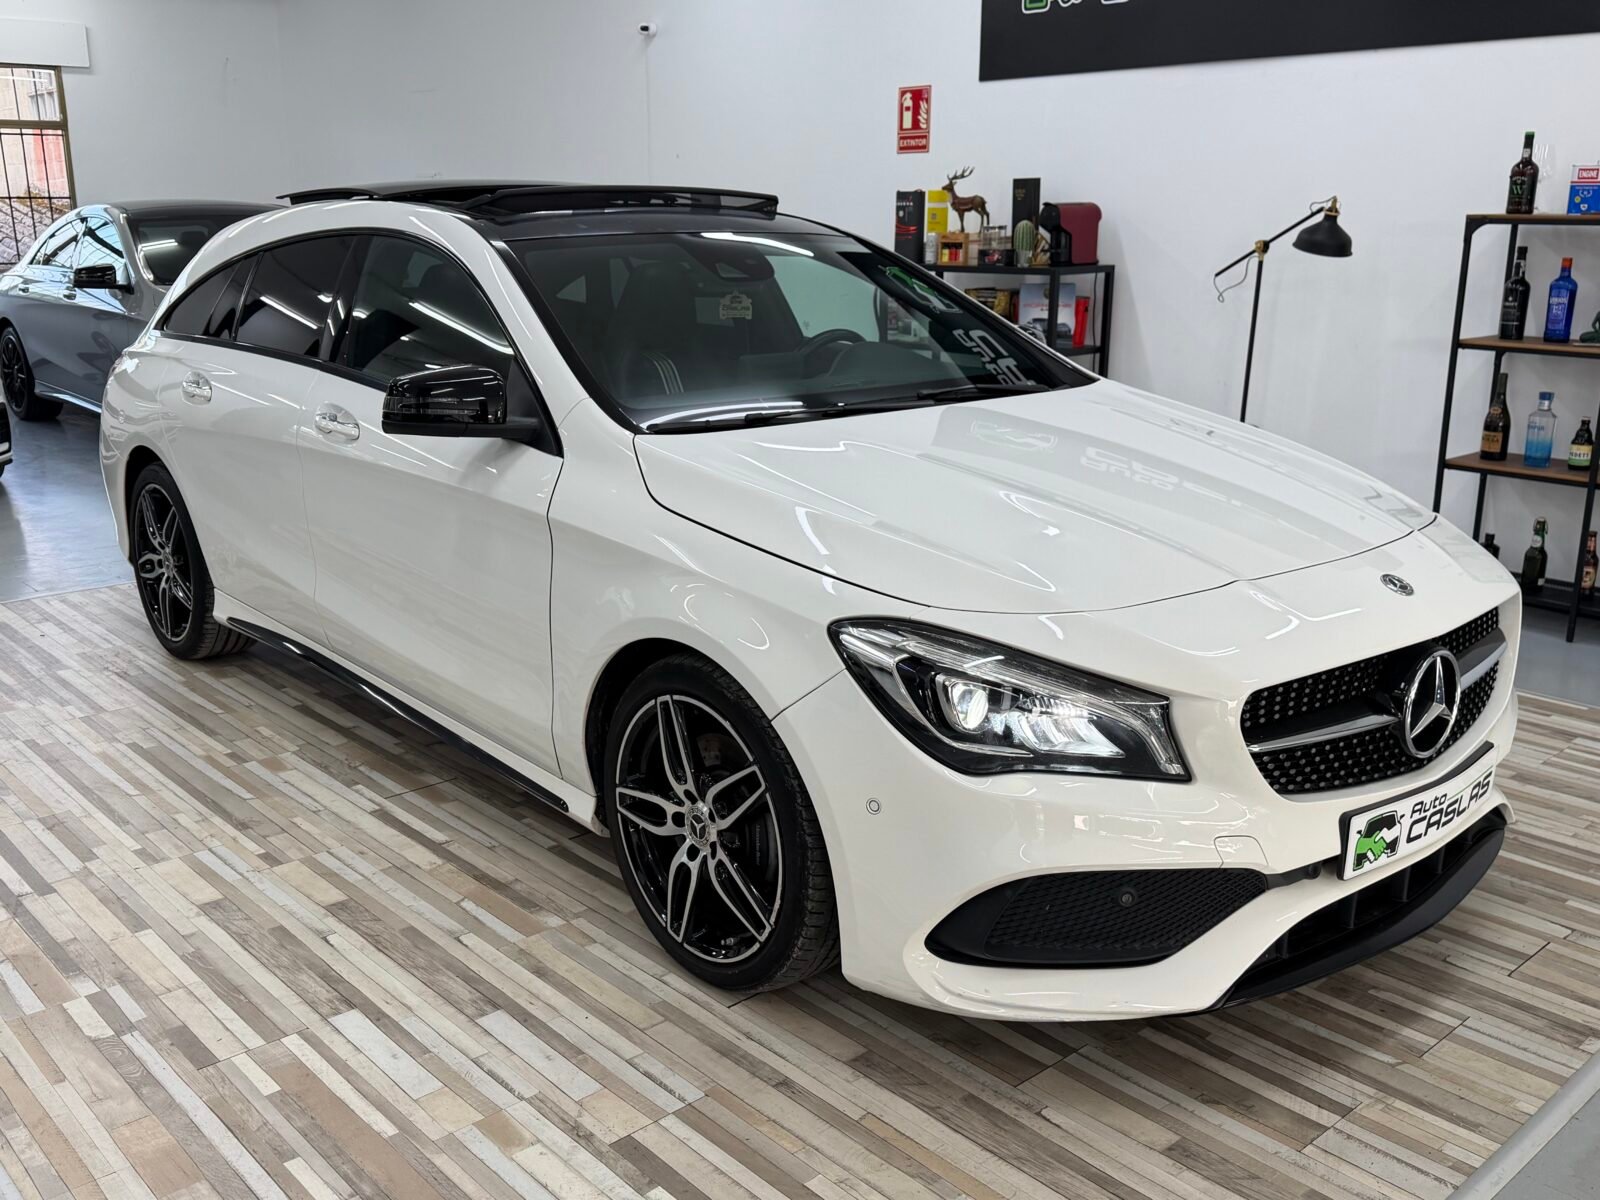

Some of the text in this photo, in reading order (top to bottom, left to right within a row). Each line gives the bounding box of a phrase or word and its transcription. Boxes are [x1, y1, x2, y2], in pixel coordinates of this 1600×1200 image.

[900, 138, 927, 147] EXTINTOR
[1406, 771, 1492, 843] CASLAS
[1410, 793, 1447, 819] Auto
